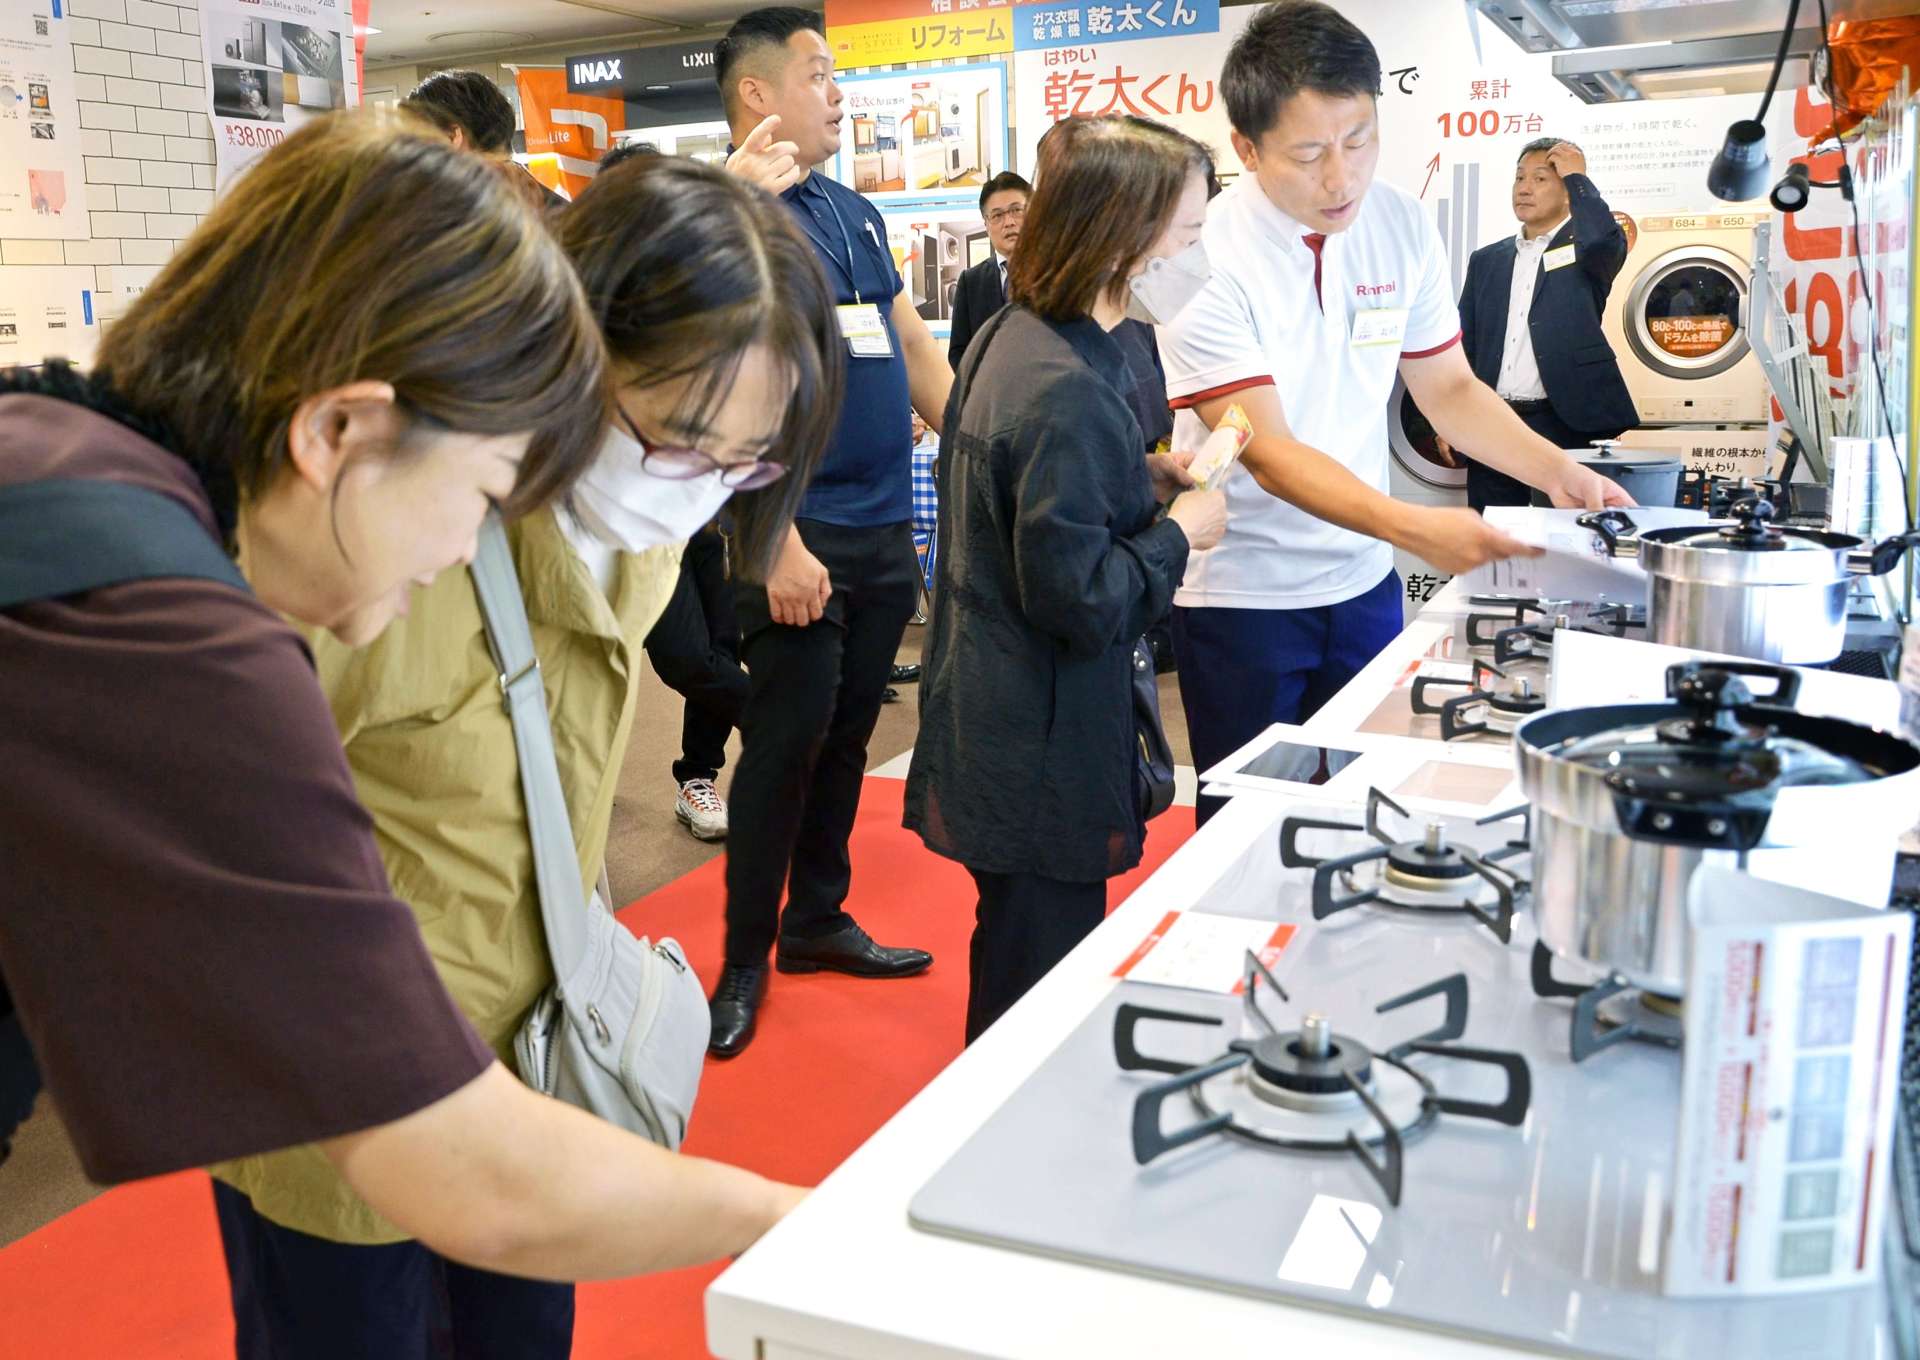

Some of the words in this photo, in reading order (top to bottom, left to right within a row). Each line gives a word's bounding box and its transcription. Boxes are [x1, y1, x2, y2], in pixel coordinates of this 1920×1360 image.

[1033, 8, 1079, 26] ガス衣類
[1087, 1, 1197, 35] 乾太くん
[912, 18, 1005, 50] リフォーム
[1044, 48, 1096, 66] はやい
[573, 59, 622, 84] INAX
[1044, 65, 1214, 121] 乾太くん
[1469, 78, 1512, 100] 累計
[1437, 109, 1544, 138] 100万台
